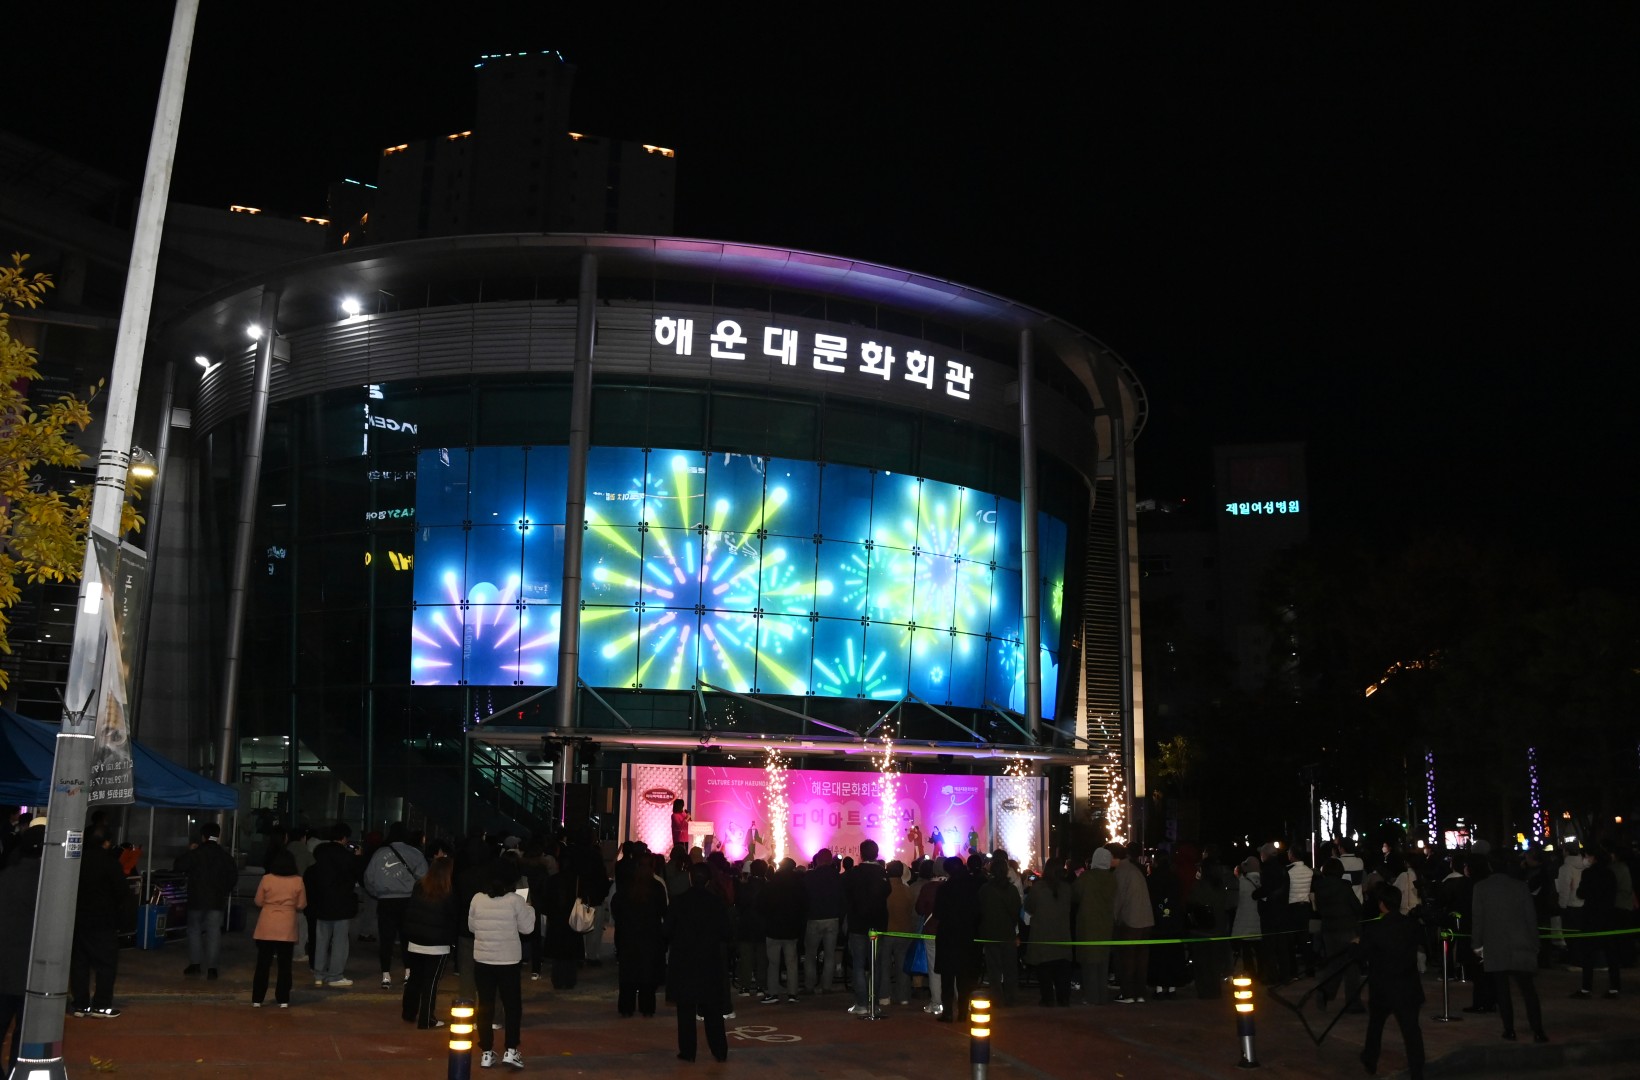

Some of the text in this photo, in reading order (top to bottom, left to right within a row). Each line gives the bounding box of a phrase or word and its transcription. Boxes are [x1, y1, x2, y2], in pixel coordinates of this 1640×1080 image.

[654, 316, 974, 400] 해운대문화회관
[1225, 500, 1299, 515] 제일여성병원
[811, 781, 881, 797] 해운대문화회관
